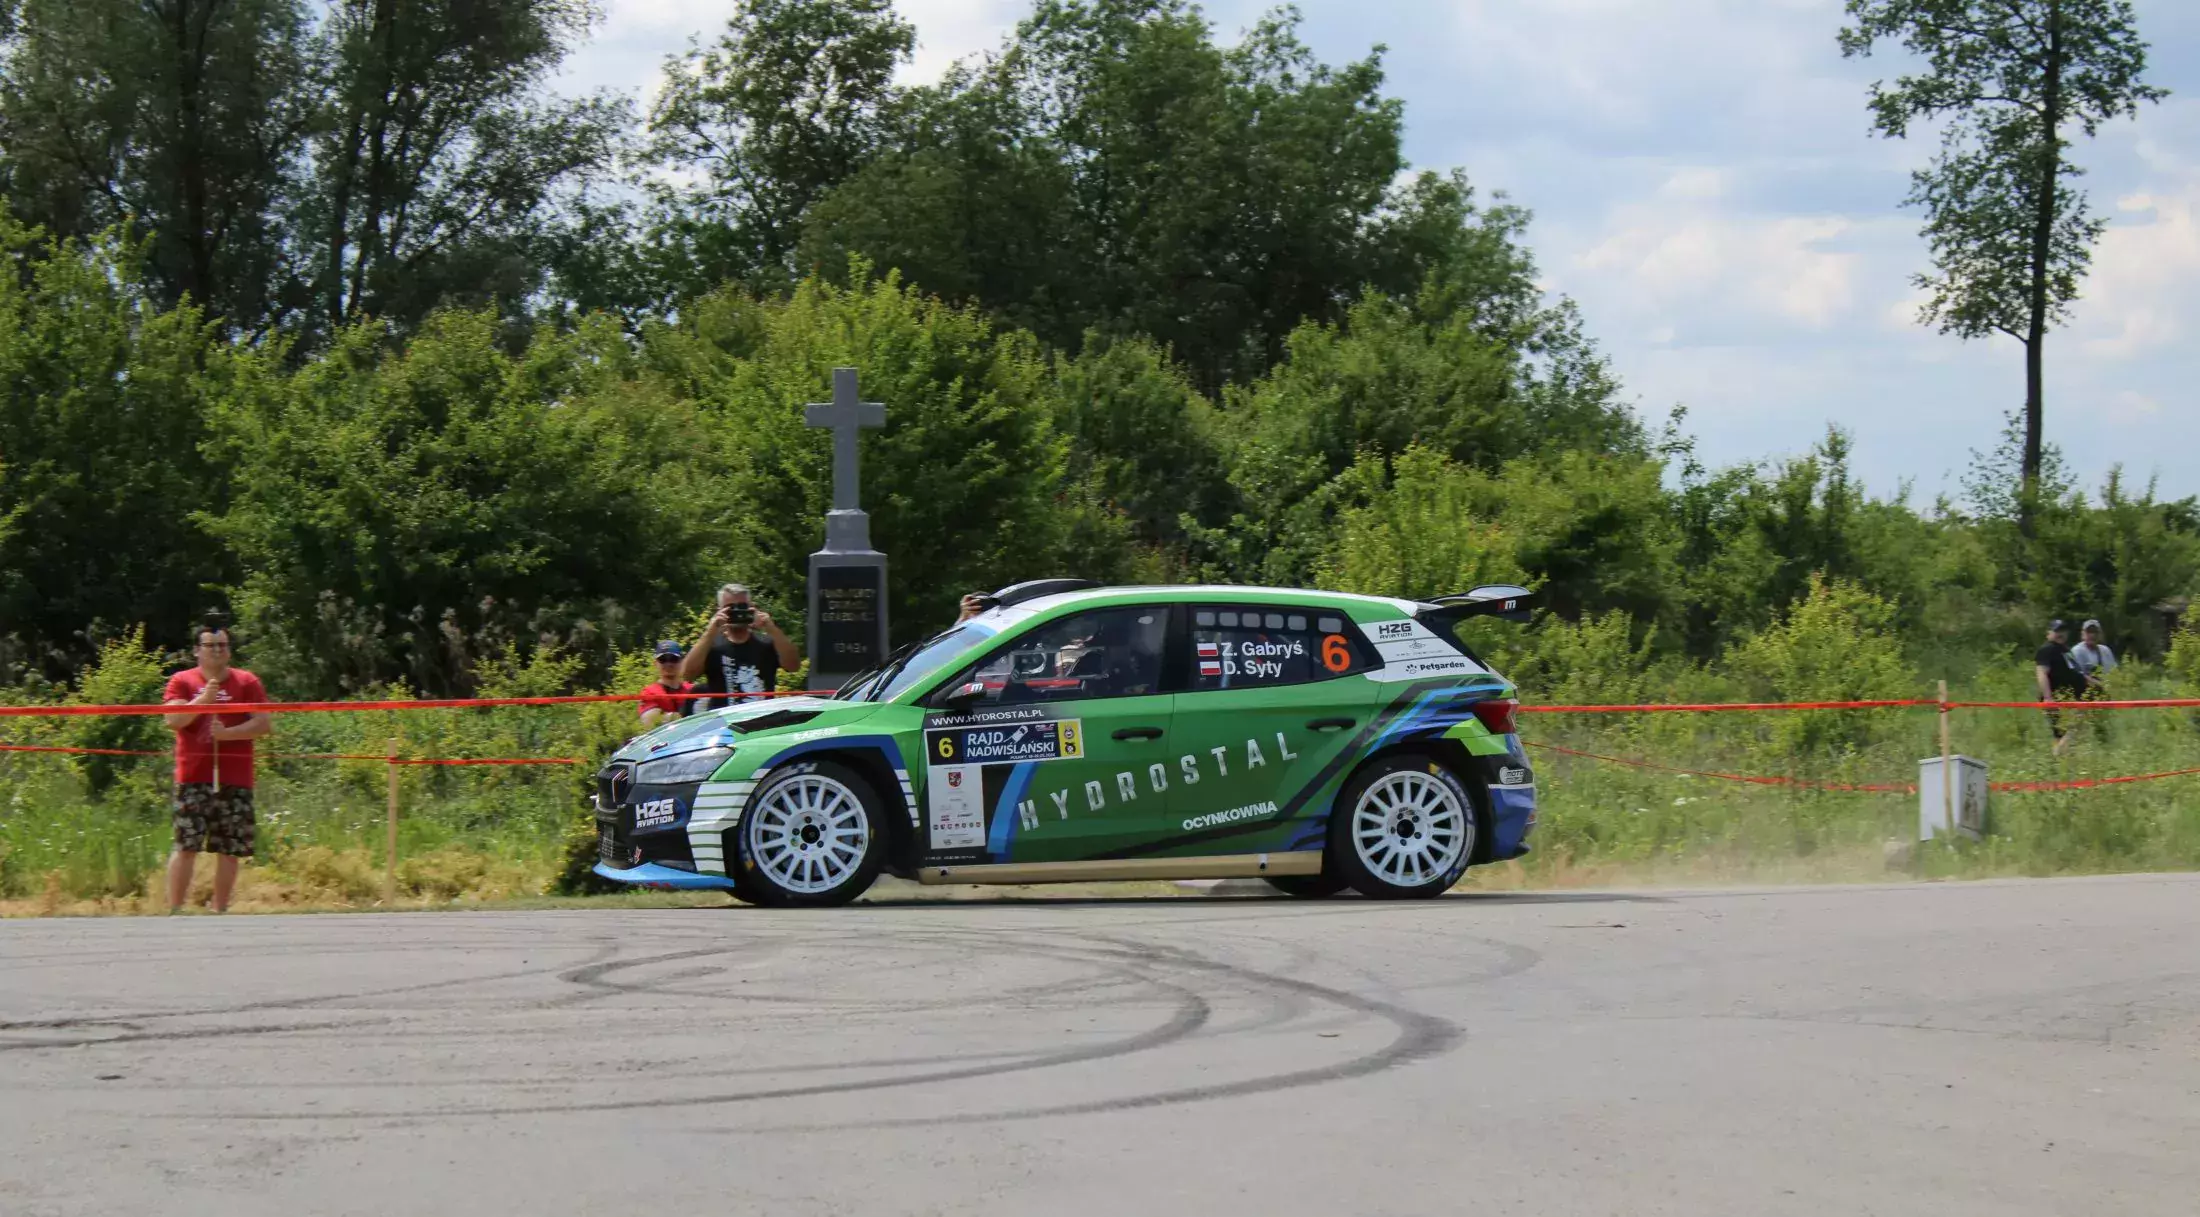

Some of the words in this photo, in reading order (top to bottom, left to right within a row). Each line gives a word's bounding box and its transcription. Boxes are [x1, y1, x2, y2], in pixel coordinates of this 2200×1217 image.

[1378, 623, 1412, 634] HZG
[1380, 632, 1412, 640] AVIATION
[1221, 642, 1238, 657] Z.
[1241, 640, 1303, 658] Gabryś
[1322, 634, 1351, 672] 6
[1223, 660, 1241, 675] D.
[1245, 660, 1282, 677] Syty
[1419, 661, 1465, 671] Petgarden
[931, 709, 1045, 726] WWW.HYDROSTAL.PL
[967, 731, 1004, 746] RAJD
[938, 737, 954, 758] 6
[966, 739, 1055, 757] NADWIŚLAŃSKI
[1018, 732, 1298, 832] HYDROSTAL
[635, 798, 675, 820] HZG
[1182, 800, 1279, 831] OCYNKOWNIA
[636, 815, 675, 829] AVIATION
